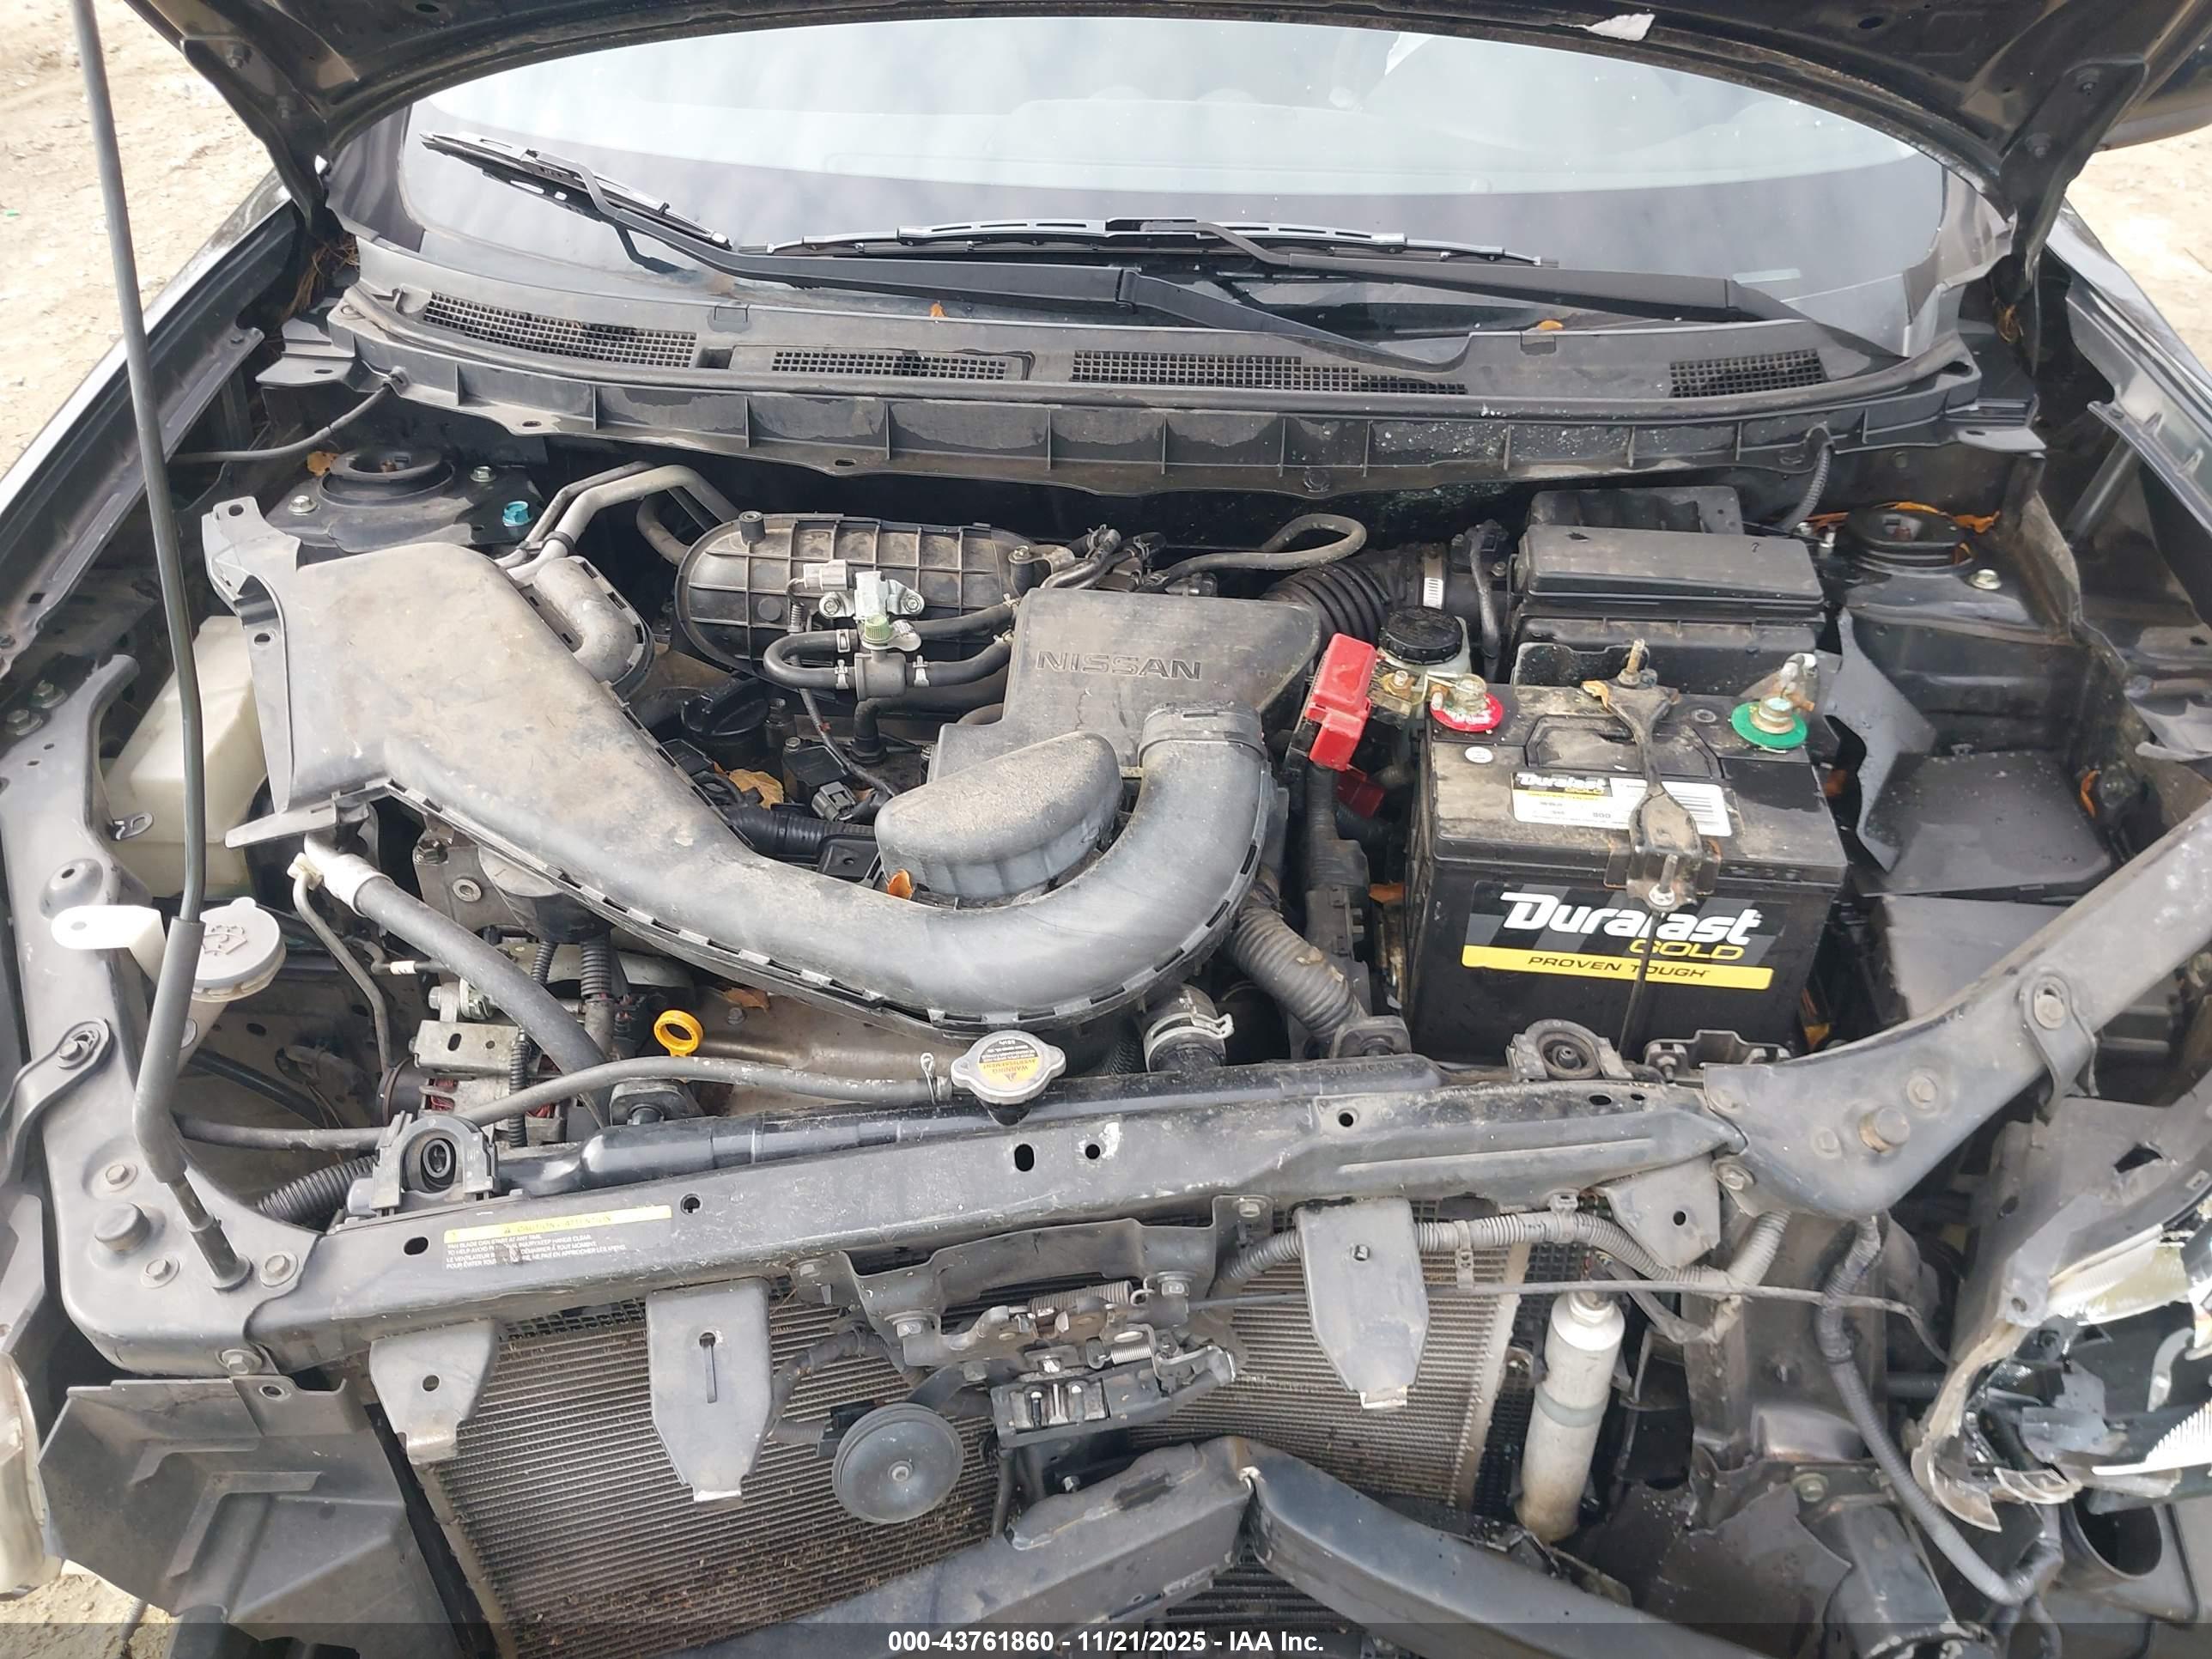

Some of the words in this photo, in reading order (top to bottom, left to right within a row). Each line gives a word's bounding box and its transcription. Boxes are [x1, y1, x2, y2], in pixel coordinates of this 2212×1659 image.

[1037, 651, 1200, 680] NISSAN
[1516, 773, 1606, 789] Duralast
[1629, 939, 1747, 961] GOLD
[1527, 957, 1622, 972] PROVEN
